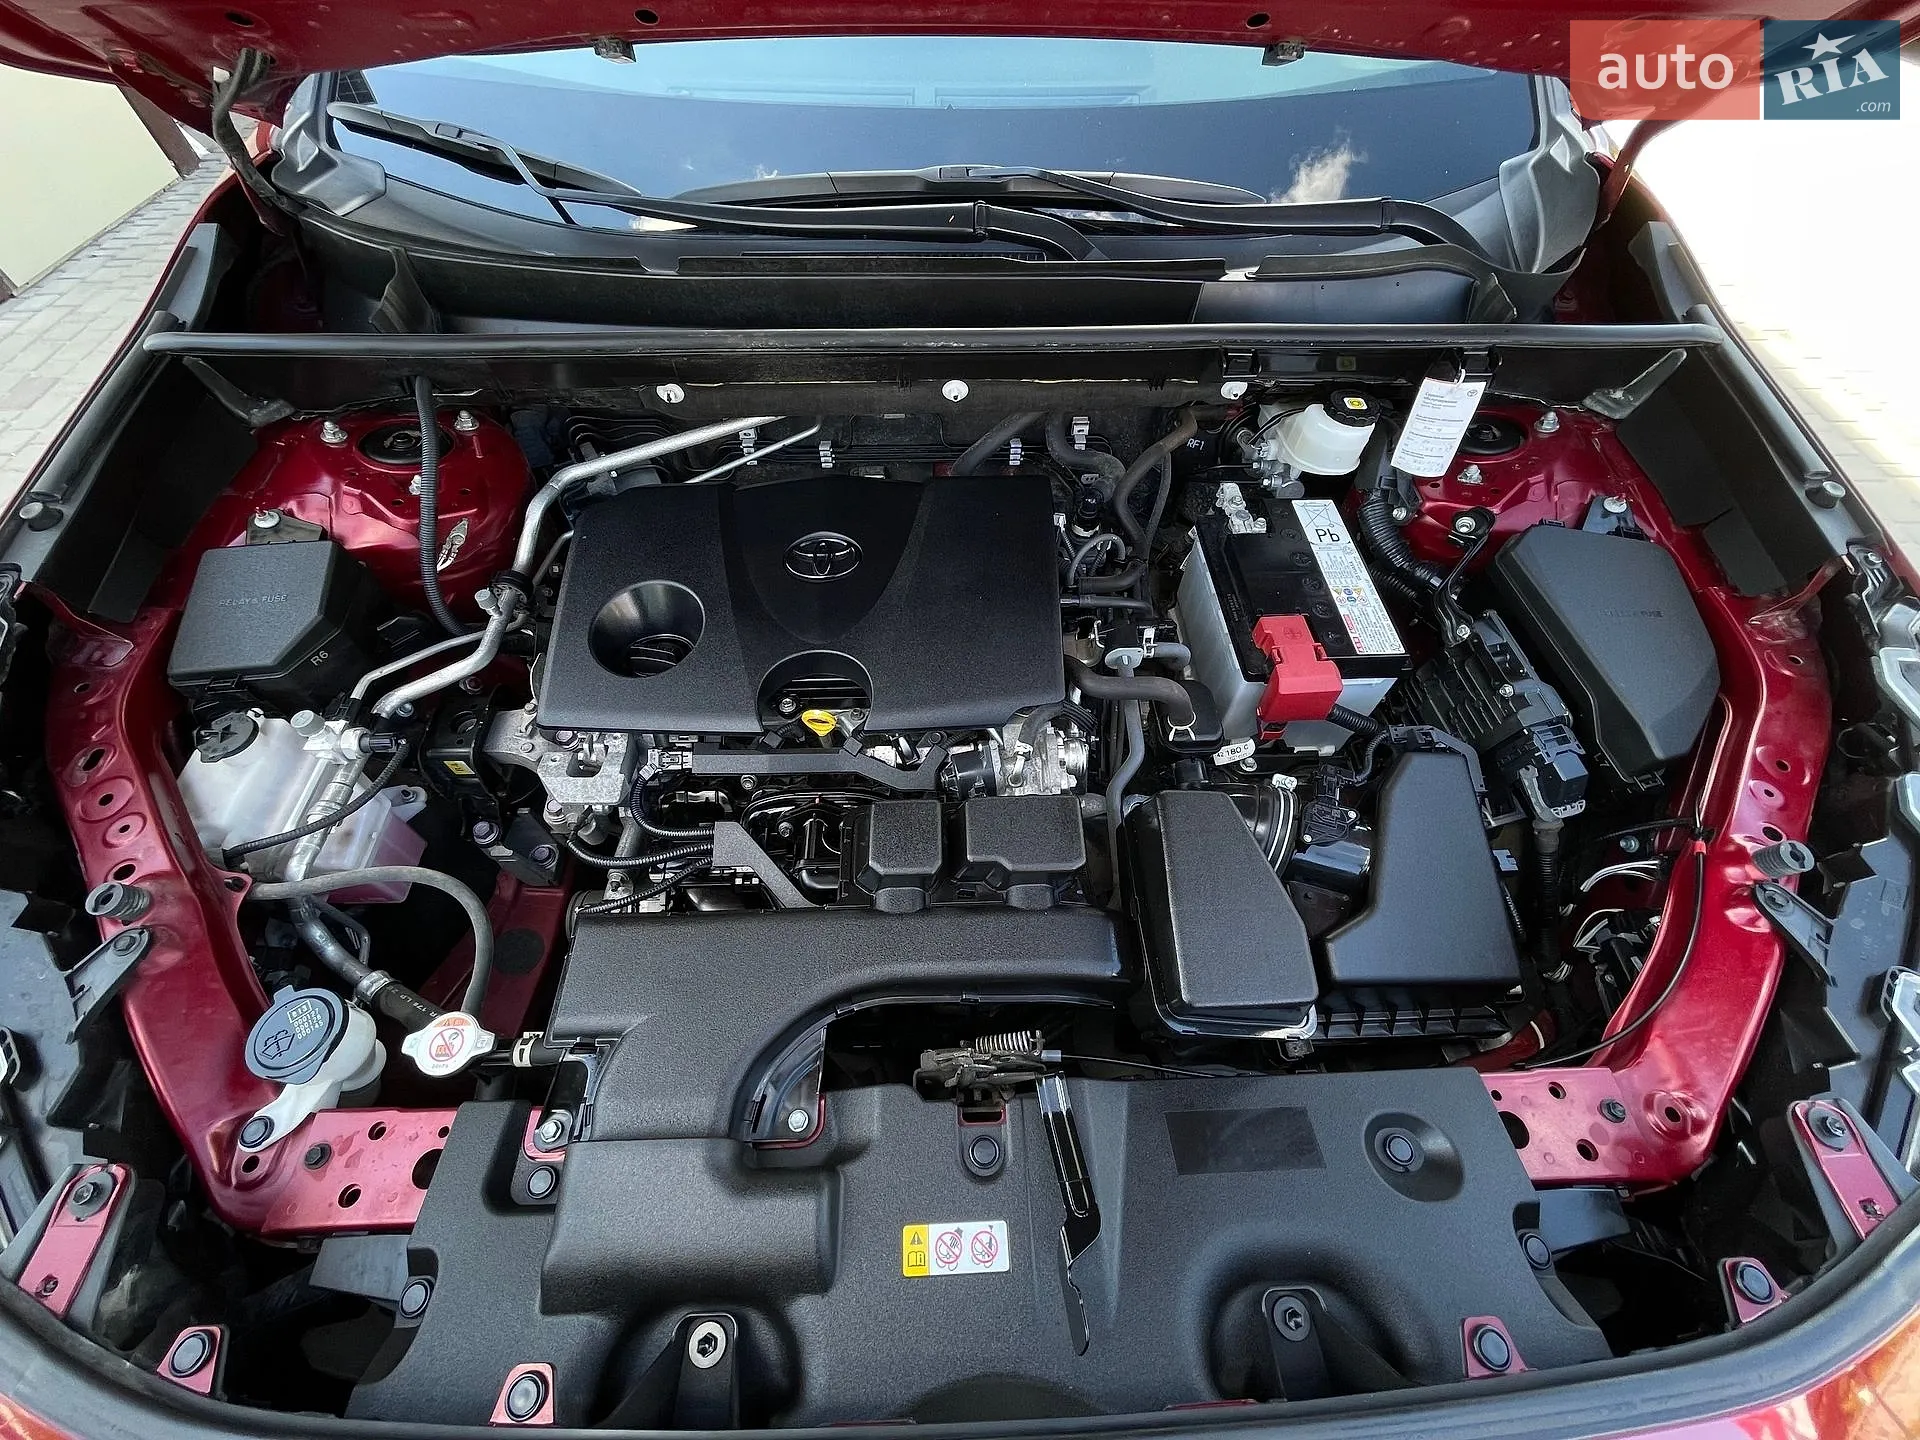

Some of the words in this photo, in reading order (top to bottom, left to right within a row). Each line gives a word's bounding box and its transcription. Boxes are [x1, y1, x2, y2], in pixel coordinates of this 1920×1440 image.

[1315, 528, 1341, 543] Pb
[261, 594, 288, 604] FUSE
[310, 650, 329, 666] R6
